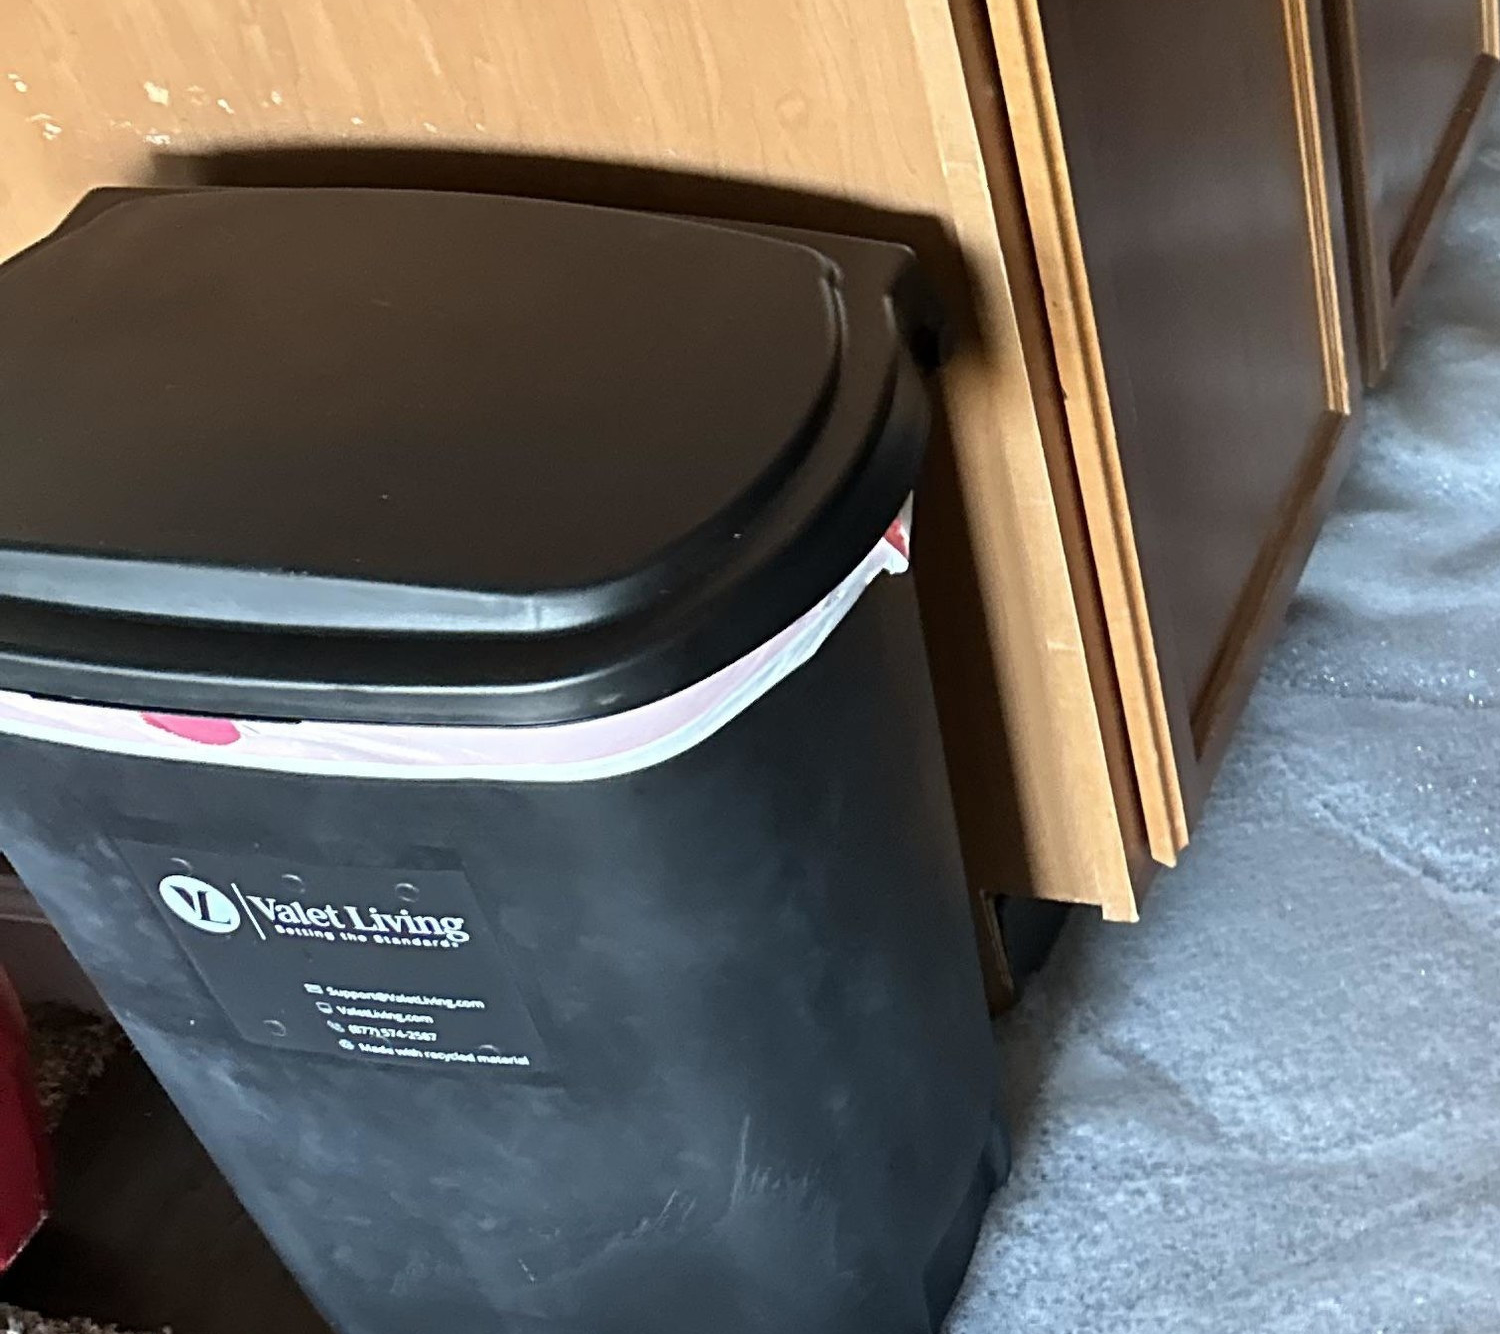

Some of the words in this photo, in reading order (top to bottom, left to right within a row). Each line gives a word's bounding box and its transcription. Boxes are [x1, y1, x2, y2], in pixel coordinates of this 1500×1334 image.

[245, 895, 345, 929] Valet
[343, 905, 471, 944] Living
[274, 924, 336, 942] Setting
[339, 931, 368, 943] the
[357, 1042, 395, 1056] Made
[394, 1047, 424, 1059] with
[423, 1050, 476, 1064] recycled
[476, 1055, 531, 1066] material
